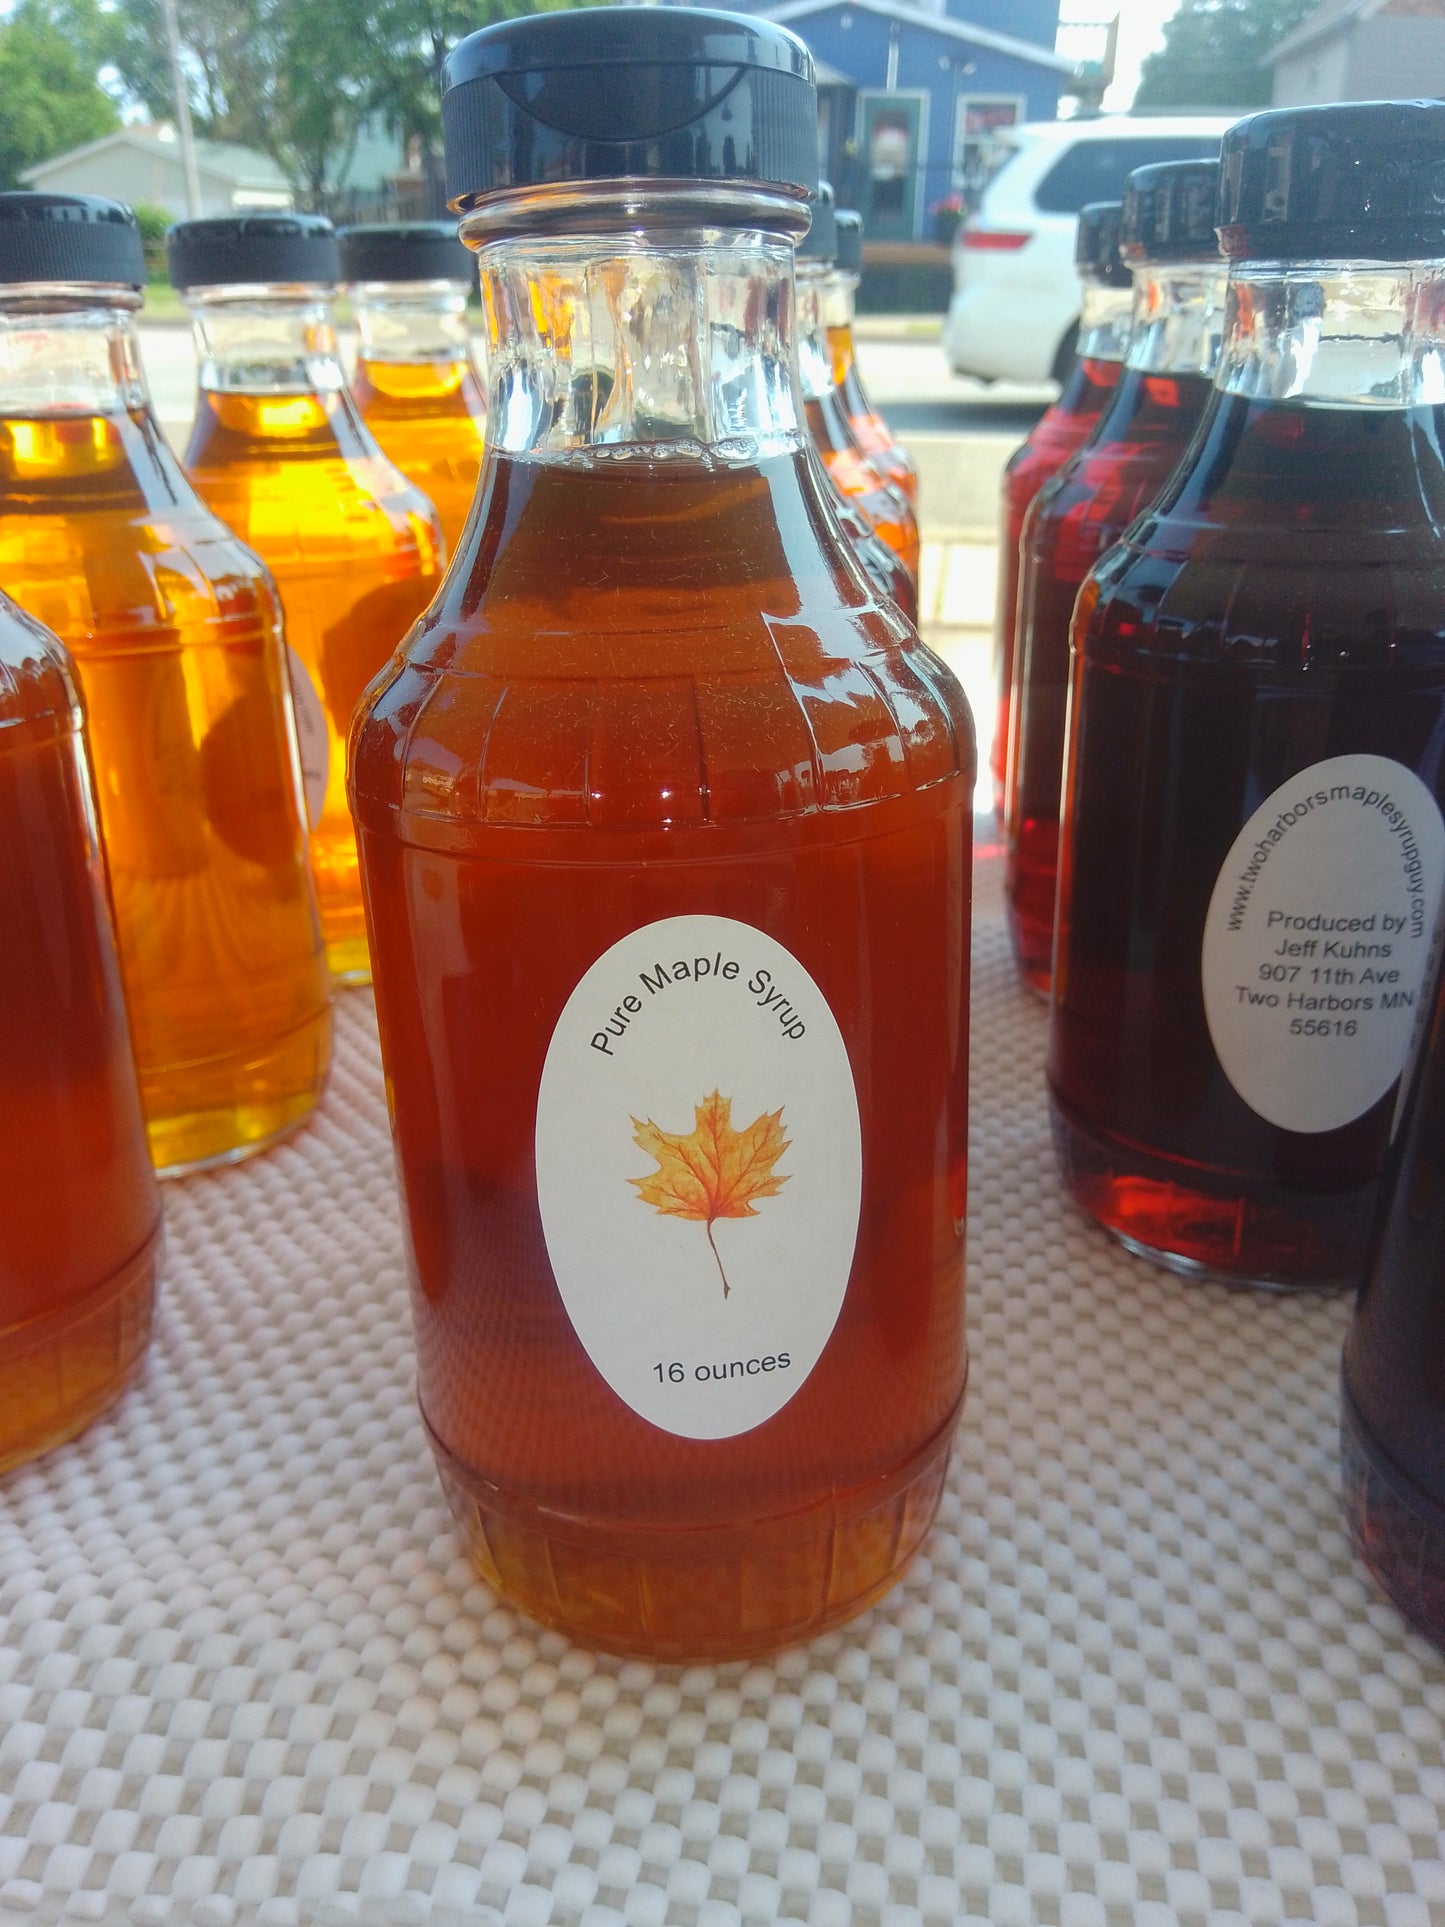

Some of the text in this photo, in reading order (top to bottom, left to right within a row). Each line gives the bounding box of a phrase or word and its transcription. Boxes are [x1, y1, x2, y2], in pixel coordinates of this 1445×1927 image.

[1227, 785, 1425, 939] www.twoharborsmaplesyrupguy.com
[1267, 911, 1407, 935] Produced by
[1274, 939, 1392, 958] Jeff Kuhns
[1259, 964, 1400, 985] 907 11th Ave
[590, 952, 807, 1056] Pure Maple Syrup
[1235, 985, 1414, 1011] Two Harbors MN
[1289, 1019, 1358, 1037] 55616
[653, 1350, 792, 1384] 16 ounces
